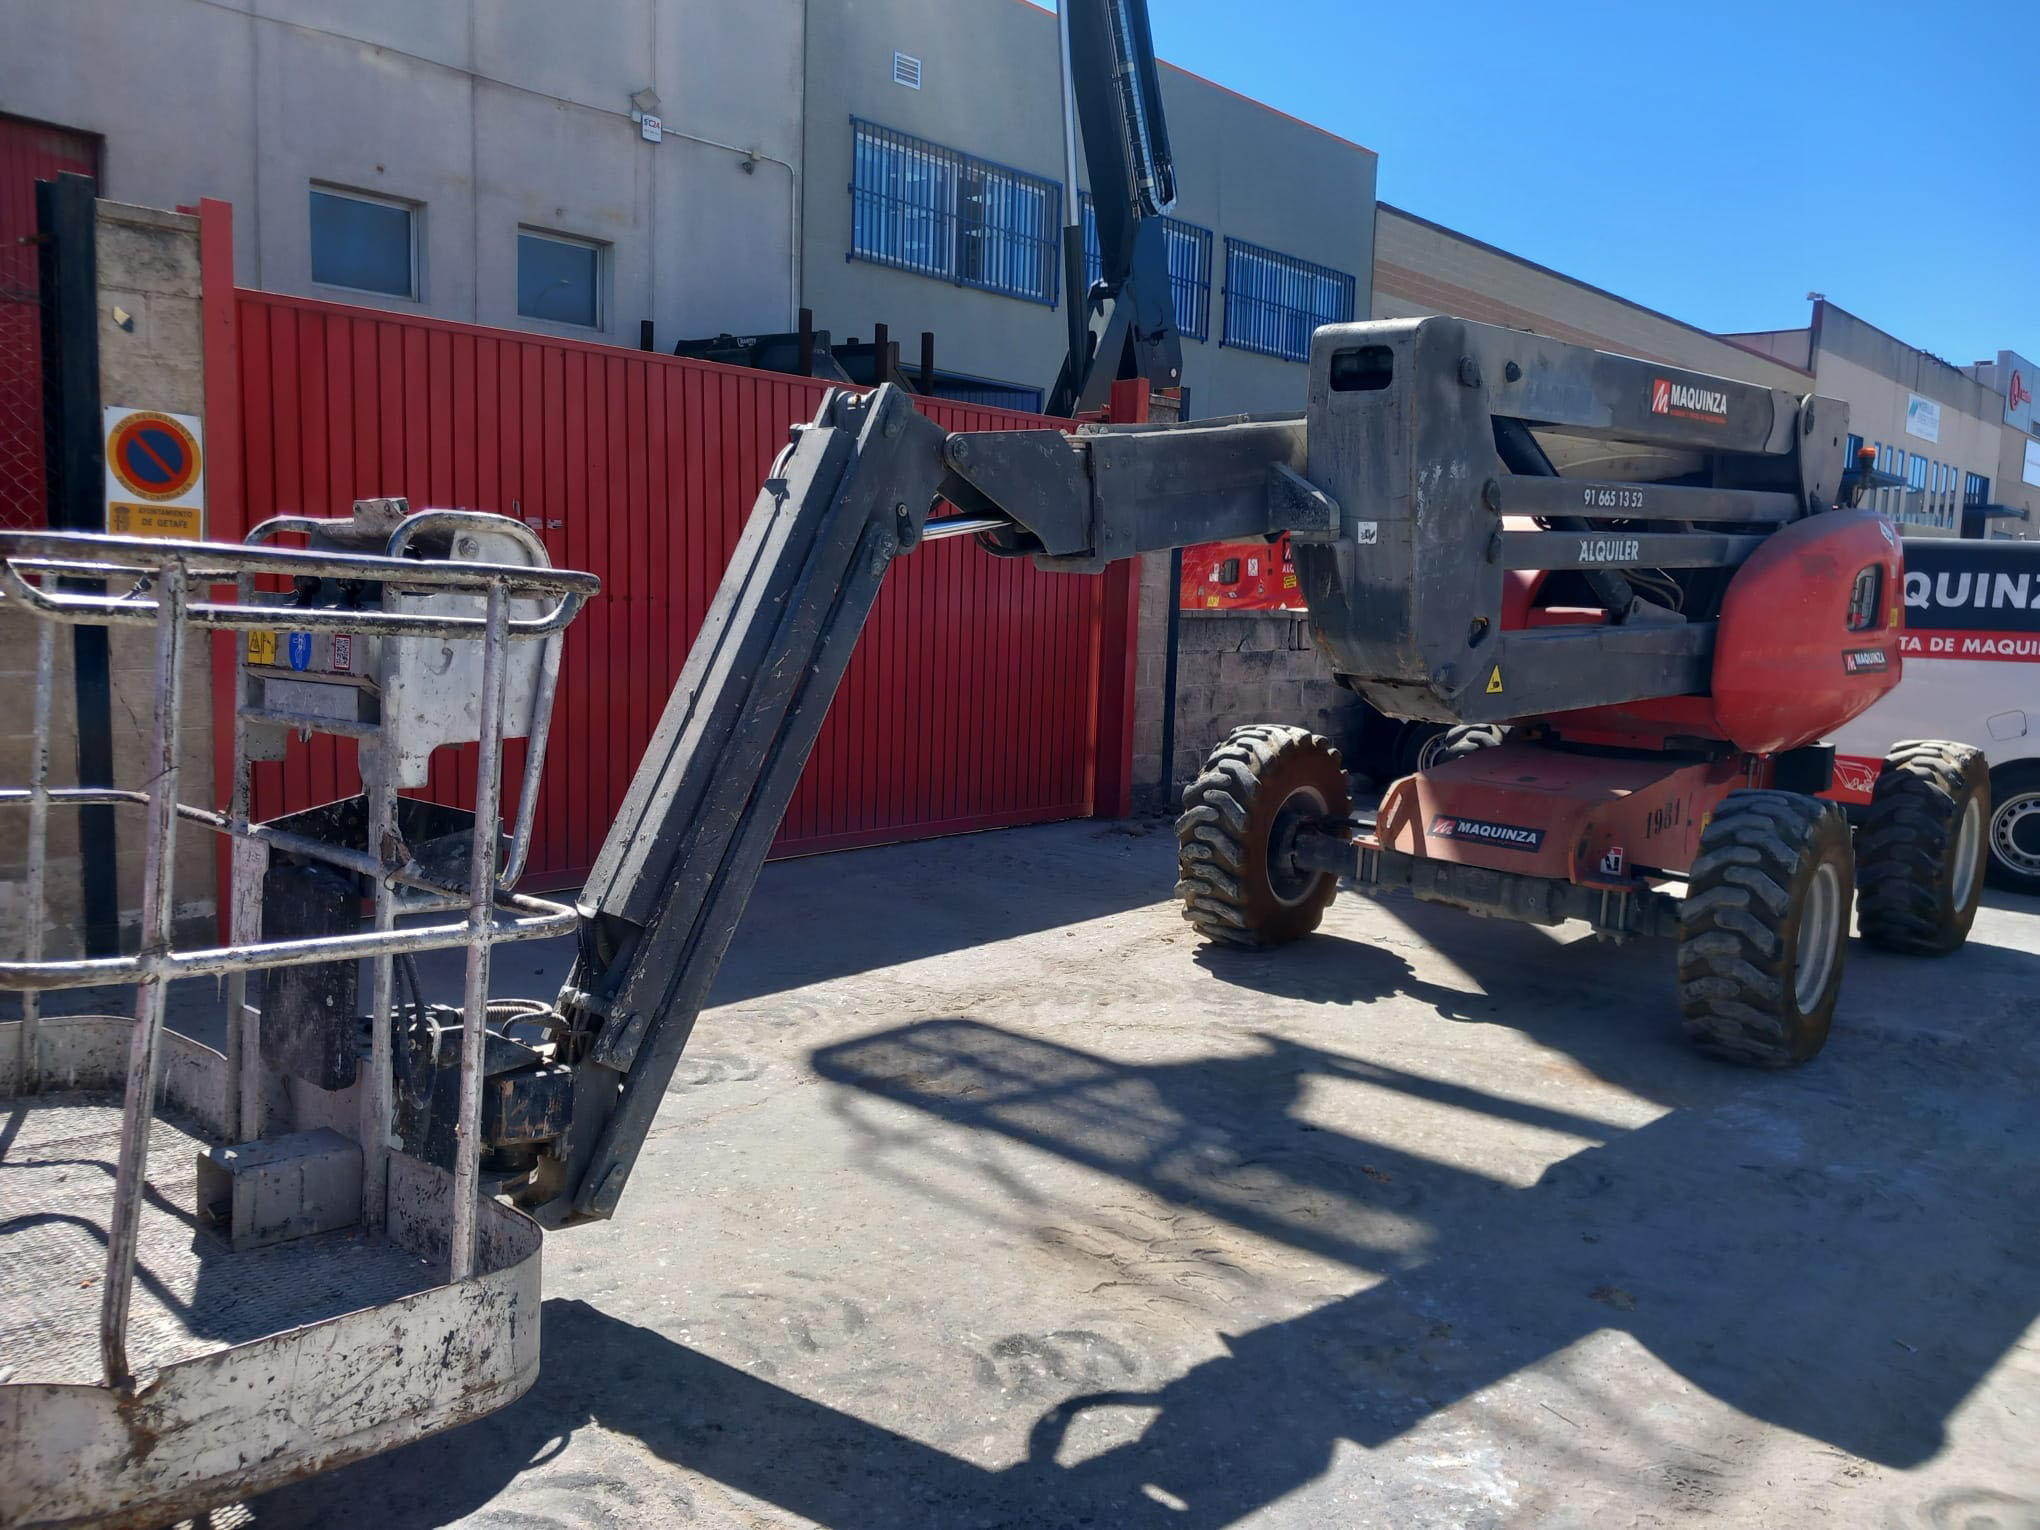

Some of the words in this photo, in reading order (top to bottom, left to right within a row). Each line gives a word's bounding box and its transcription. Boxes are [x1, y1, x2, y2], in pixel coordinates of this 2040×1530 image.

[1670, 384, 1727, 415] MAQUINZA
[1584, 489, 1596, 505] 91
[1598, 490, 1616, 506] 665
[1619, 491, 1630, 507] 13
[1631, 492, 1643, 508] 52
[142, 517, 153, 526] DE
[157, 519, 188, 529] GETAFE
[1579, 541, 1639, 562] ALQUILER
[1930, 637, 1955, 652] DE
[1961, 638, 2040, 656] MAQUI
[1855, 651, 1886, 665] MAQUINZA
[1457, 820, 1537, 845] MAQUINZA
